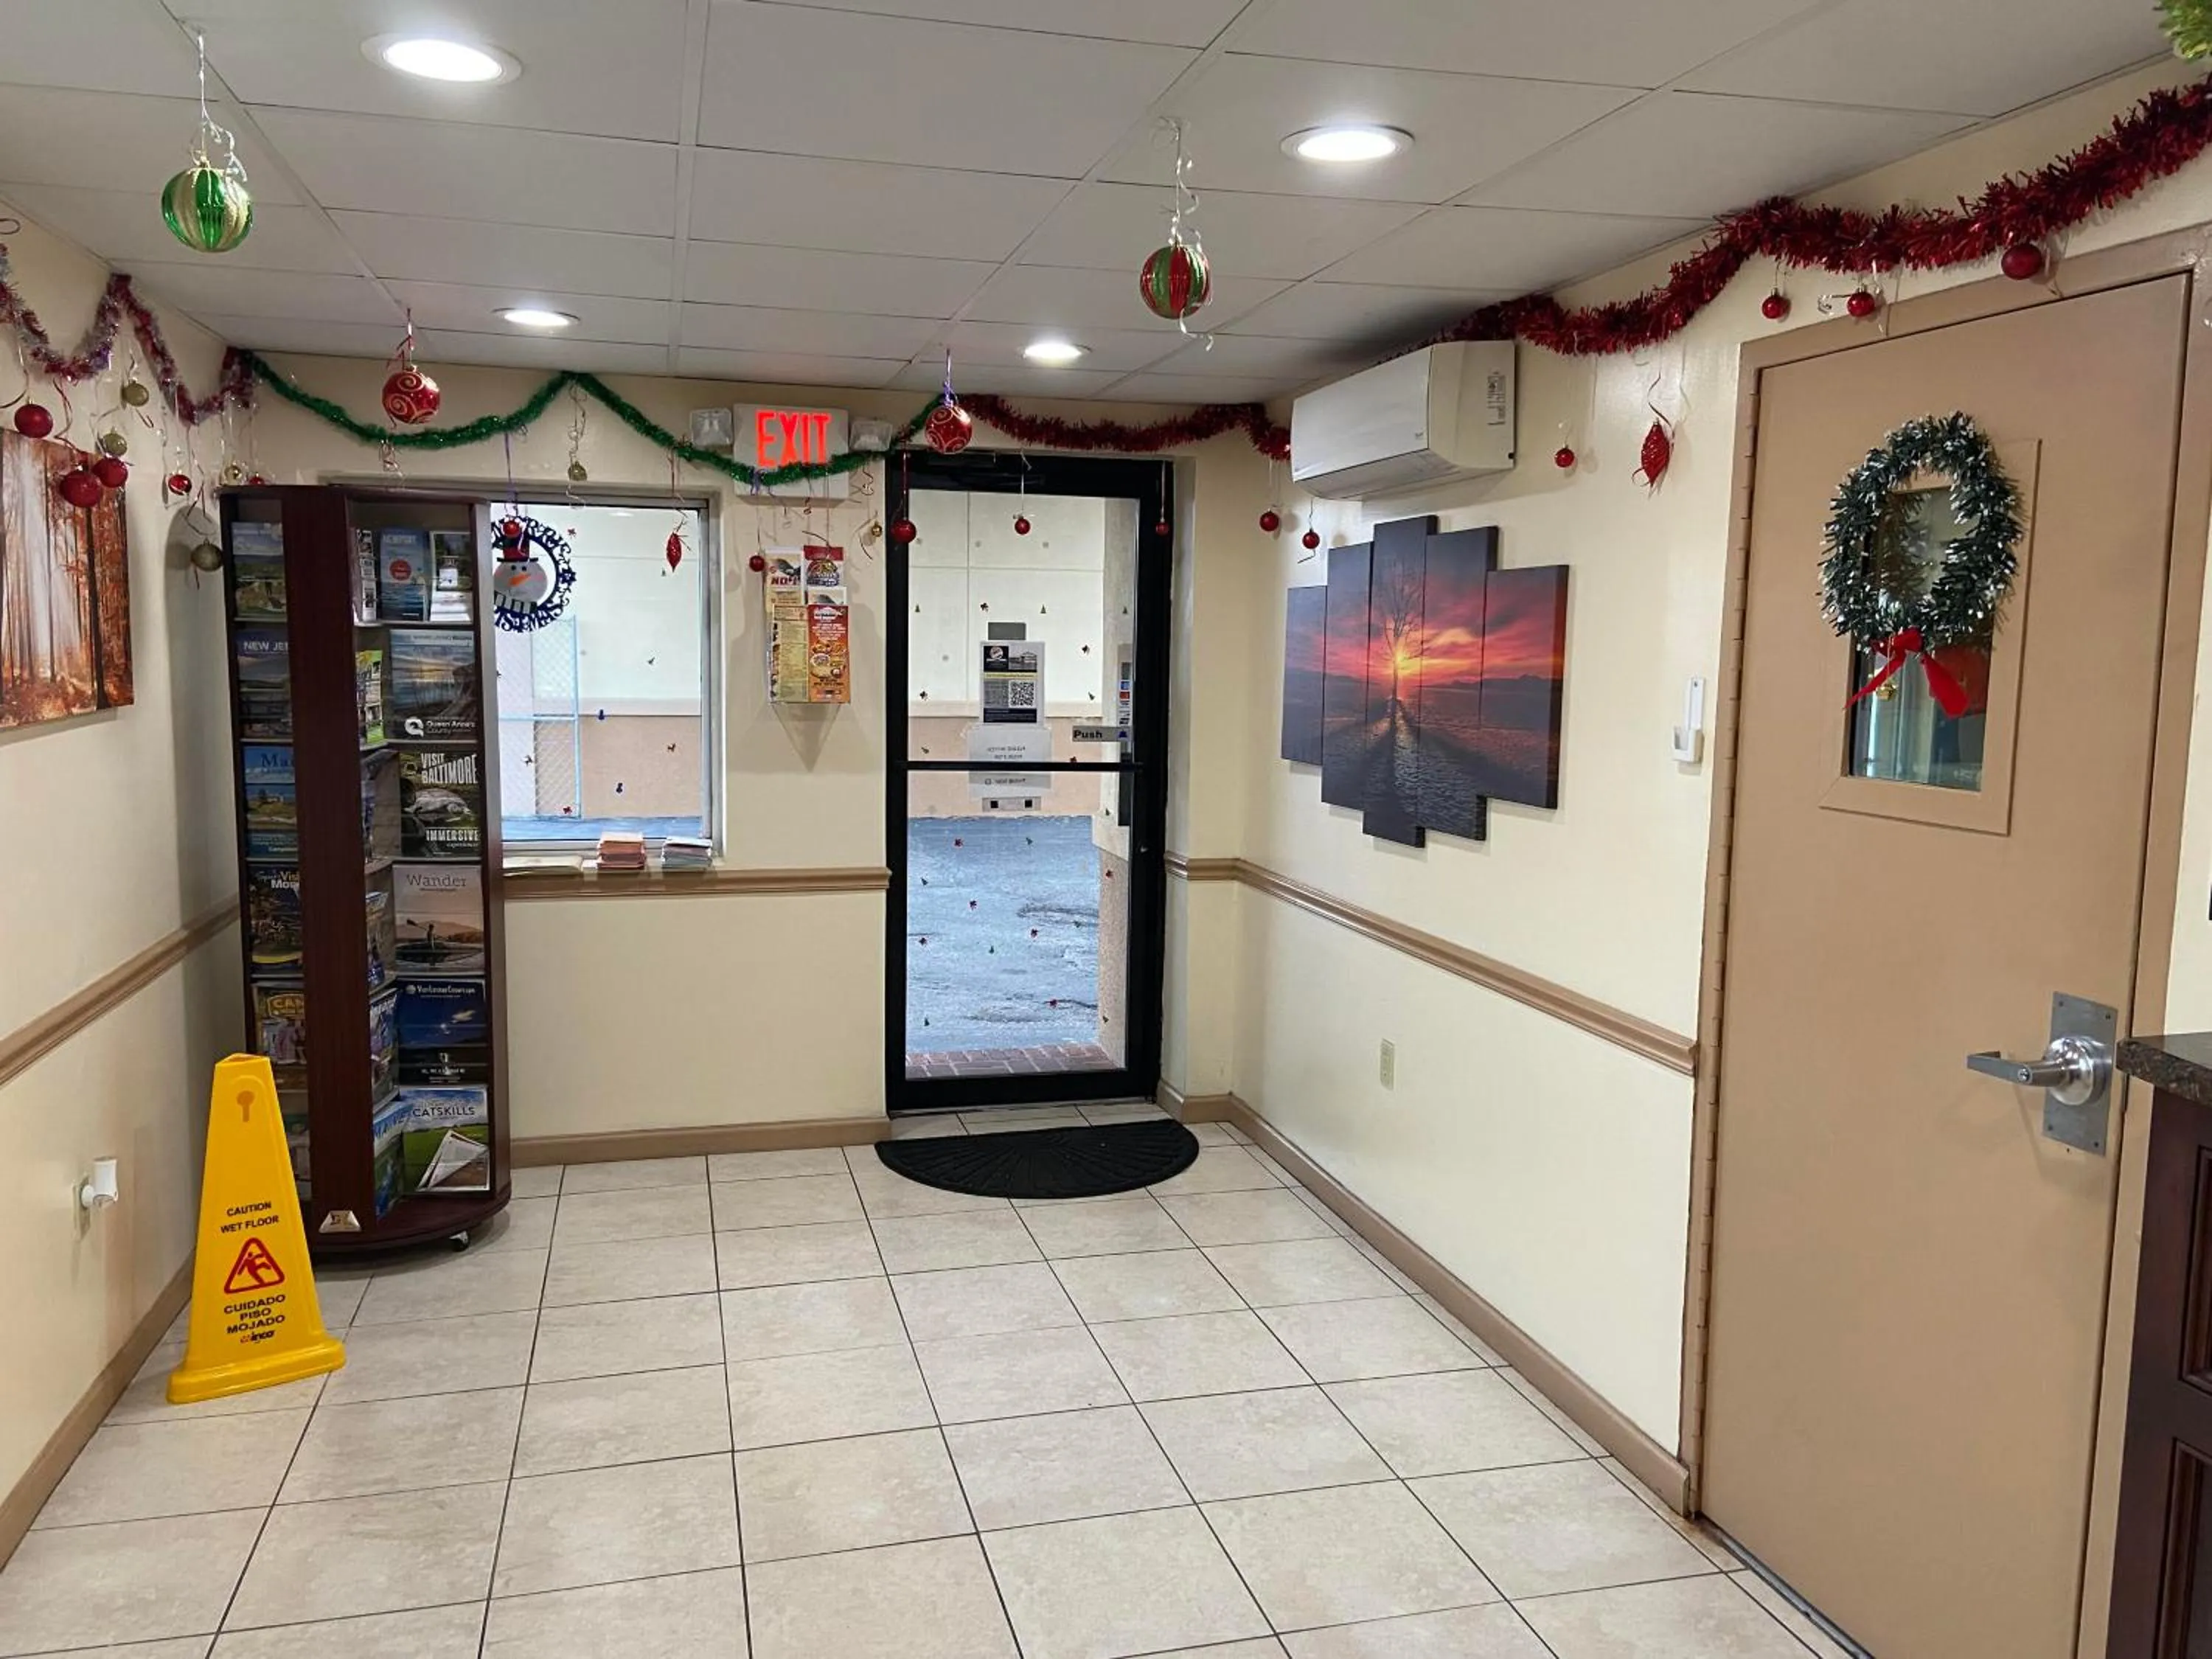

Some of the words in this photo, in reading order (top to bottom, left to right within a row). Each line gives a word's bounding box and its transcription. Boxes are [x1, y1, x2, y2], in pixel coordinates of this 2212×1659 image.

[756, 409, 832, 467] EXIT
[243, 641, 269, 651] NEW
[1074, 730, 1102, 738] Push
[261, 753, 294, 768] Ma
[421, 754, 445, 768] VISIT
[421, 754, 479, 785] BALTIMORE
[425, 830, 480, 841] IMMERSIVE
[407, 874, 467, 888] Wander
[412, 1107, 476, 1117] CATSKILLS
[226, 1202, 271, 1217] CAUTION
[220, 1222, 243, 1234] WET
[246, 1214, 279, 1228] FLOOR
[224, 1294, 286, 1314] CUIDADO
[240, 1307, 271, 1321] PISO
[226, 1315, 285, 1334] MOJADO
